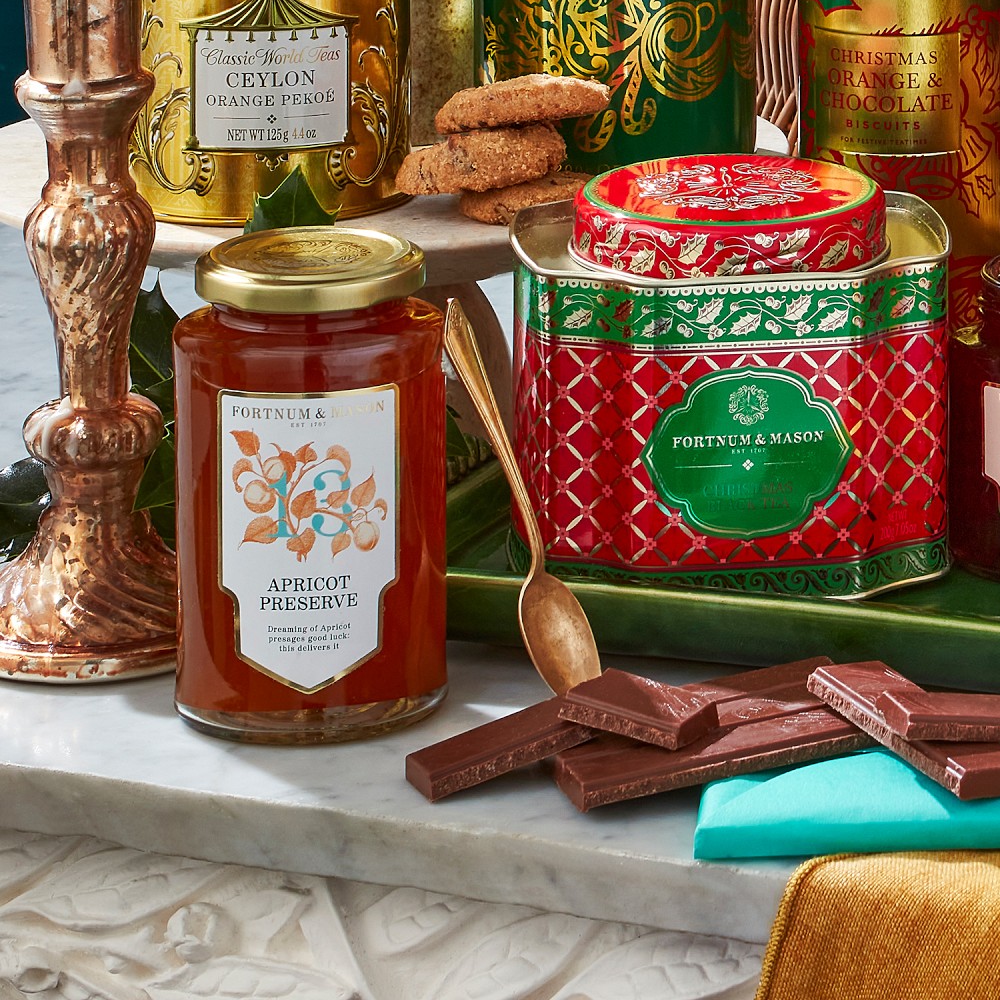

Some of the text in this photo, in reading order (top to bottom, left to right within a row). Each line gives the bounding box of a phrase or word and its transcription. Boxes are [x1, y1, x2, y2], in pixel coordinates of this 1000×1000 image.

[201, 45, 341, 67] Classic World Teas
[830, 47, 938, 66] CHRISTMAS
[225, 69, 316, 88] CEYLON
[828, 67, 943, 90] ORANGE &
[206, 94, 276, 107] ORANGE
[820, 89, 953, 113] CHOCOLATE
[846, 119, 921, 131] BISCUITS
[227, 128, 317, 144] NET WT 125g 4.4 oz
[232, 400, 385, 420] FORTNUM & MASON
[672, 430, 825, 449] FORTNUM & MASON
[703, 480, 793, 497] CHRISTMAS
[707, 497, 790, 512] BLACK TEA
[267, 575, 351, 593] APRICOT
[260, 593, 358, 611] PRESERVE
[267, 623, 351, 634] Dreaming of Apricot
[268, 634, 306, 644] presages
[308, 633, 328, 643] good
[279, 642, 340, 652] this delivers it
